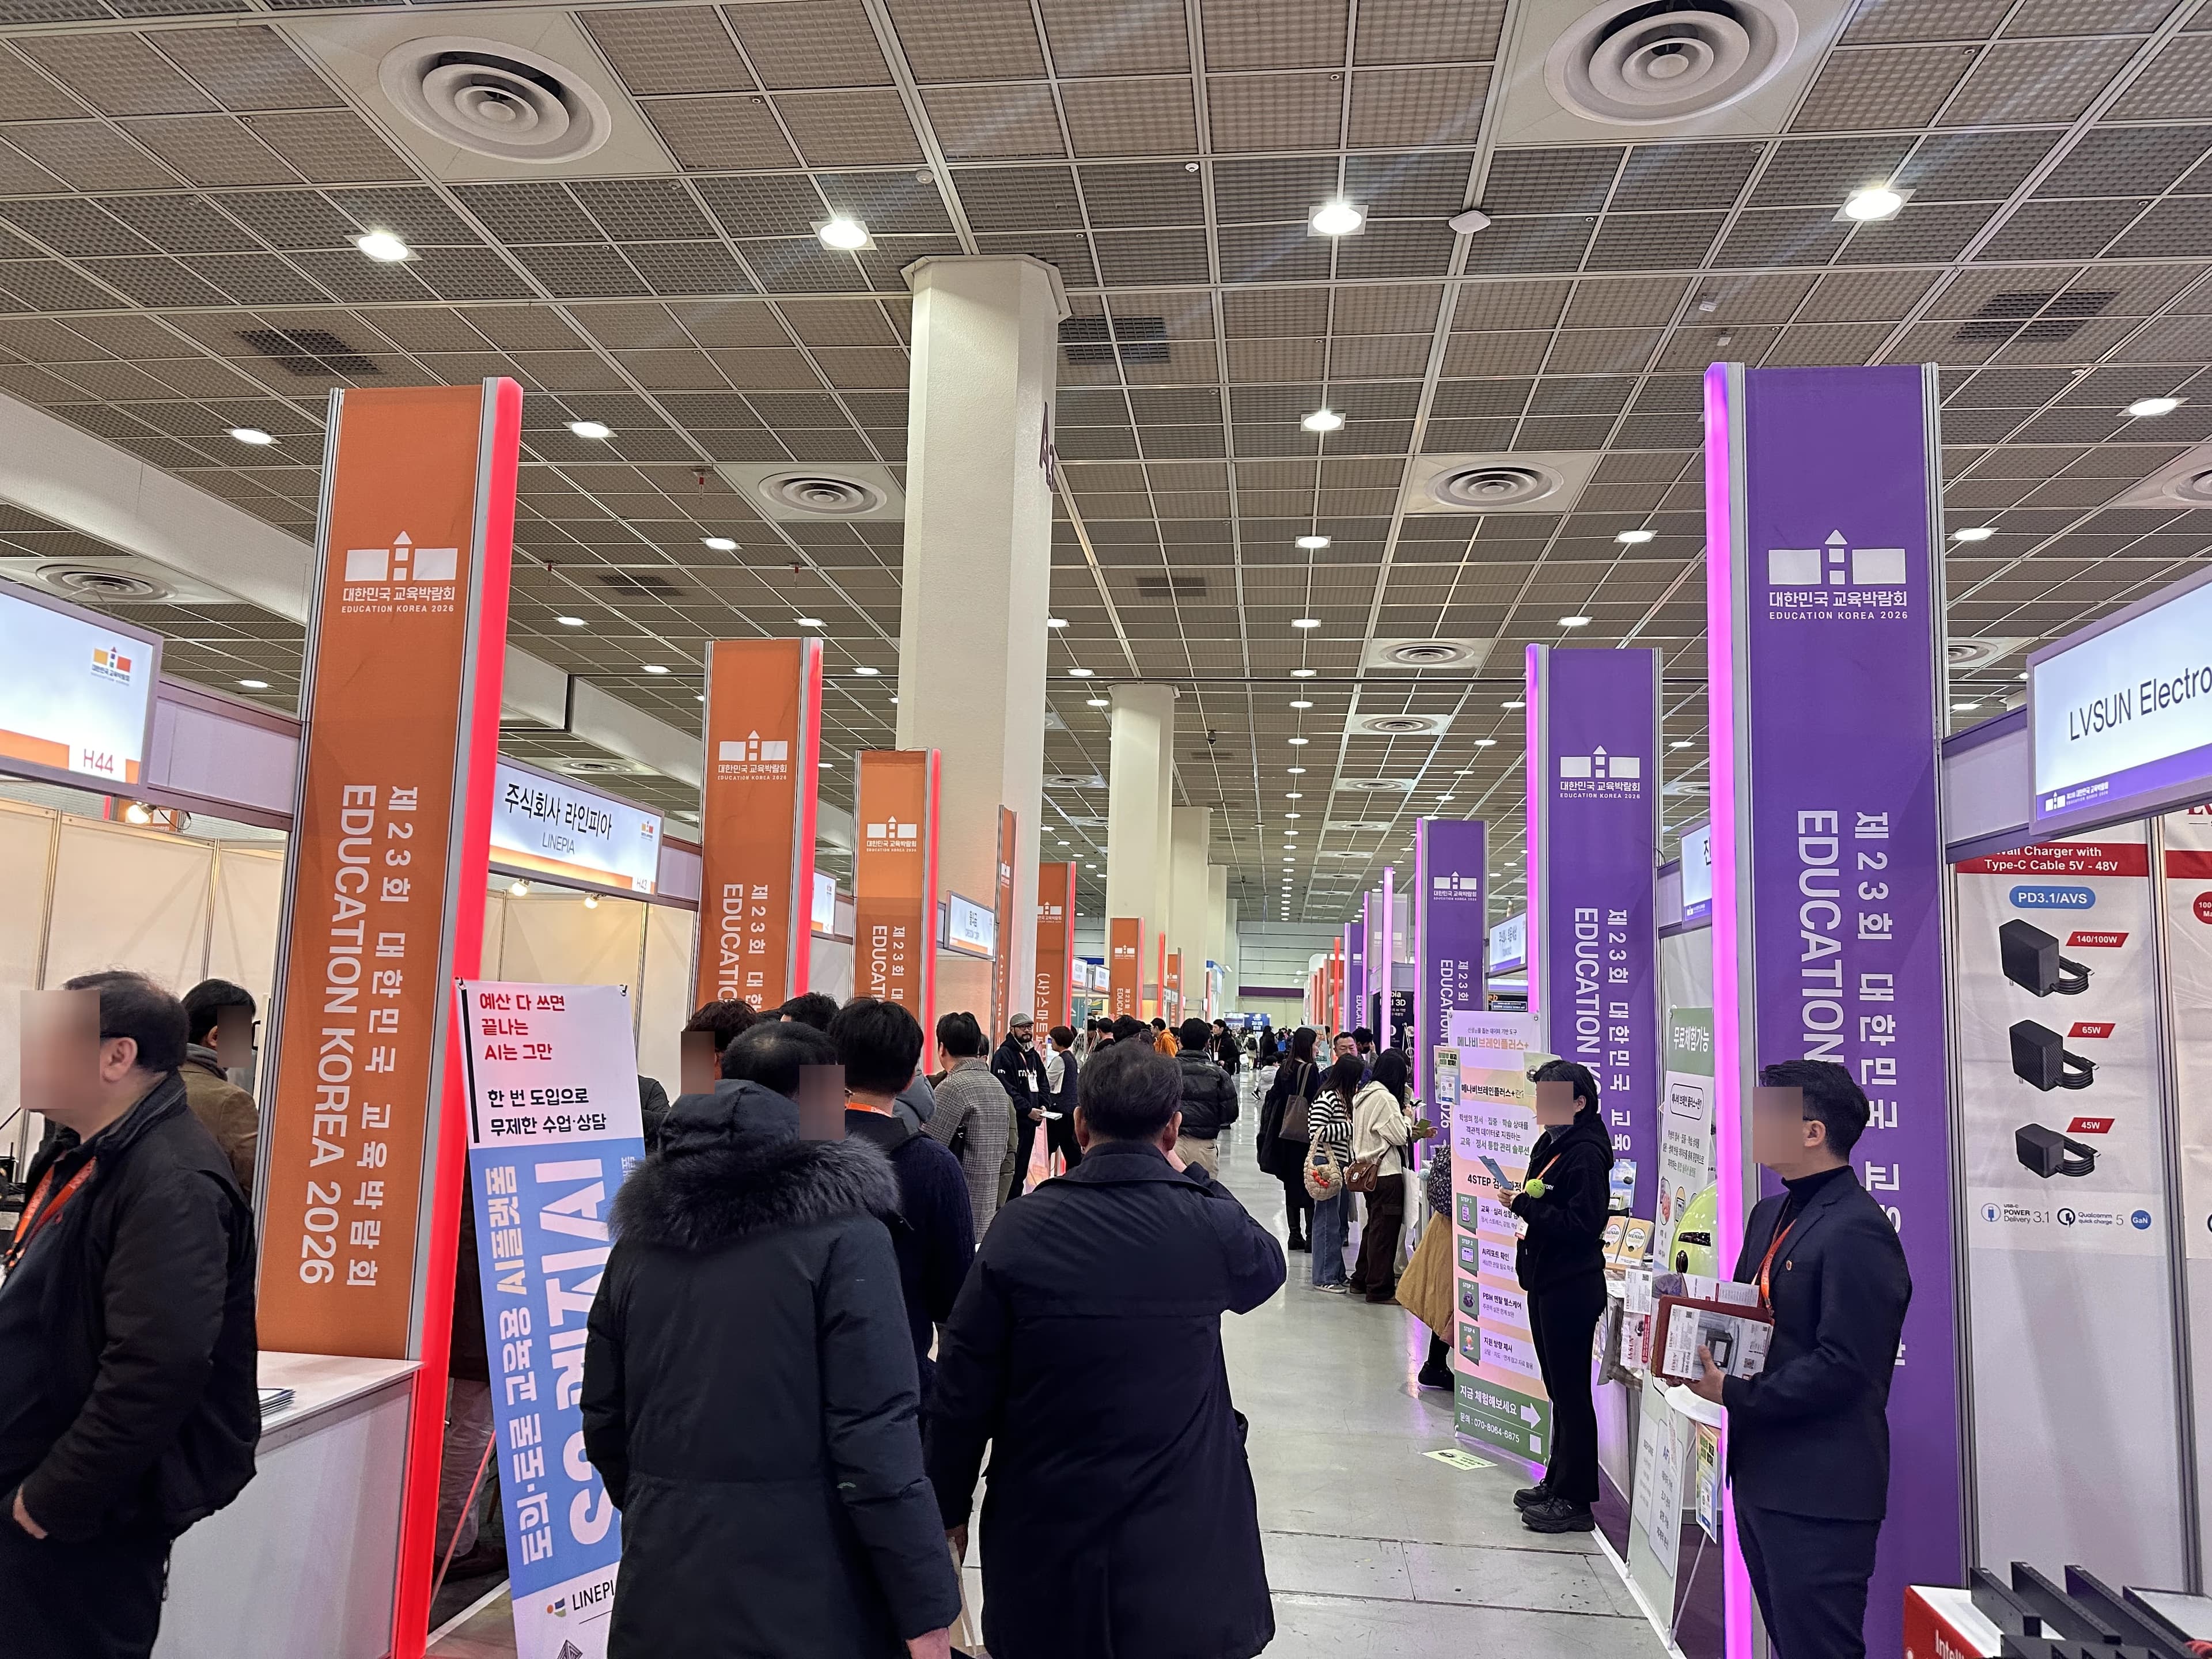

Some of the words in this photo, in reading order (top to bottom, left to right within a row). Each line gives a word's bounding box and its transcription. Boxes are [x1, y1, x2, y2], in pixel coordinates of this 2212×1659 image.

[343, 587, 391, 601] 대한민국
[393, 586, 455, 601] 교육박람회
[1769, 592, 1828, 608] 대한민국
[1833, 590, 1907, 607] 교육박람회
[1838, 612, 1874, 620] KOREA
[1880, 611, 1908, 619] 2026
[2070, 688, 2132, 741] LVSUN
[83, 749, 113, 774] H44
[718, 764, 748, 773] 대한민국
[749, 764, 787, 773] 교육박람회
[1560, 782, 1594, 791] 대한민국
[1597, 782, 1640, 791] 교육박람회
[505, 783, 560, 825] 주식회사
[565, 802, 612, 840] 라인피아
[380, 786, 418, 902] 제23회
[542, 832, 575, 855] LINEPIA
[2024, 846, 2073, 858] Charger
[2077, 847, 2101, 857] with
[1854, 811, 1893, 940] 제23회
[1984, 859, 2026, 871] Type-C
[2031, 860, 2065, 870] Cable
[2069, 861, 2084, 870] 5V
[2096, 862, 2118, 871] 48V
[324, 785, 377, 1013] EDUCATION
[2018, 893, 2088, 904] PD3.1/AVS
[748, 884, 769, 955] 제23회
[717, 884, 744, 1002] EDUCATIO
[891, 926, 905, 976] 제23회
[1607, 909, 1628, 983] 제23회
[1797, 810, 1844, 1063] EDUCATION
[870, 926, 887, 1001] EDUCATI
[745, 972, 764, 1012] 대한
[1458, 960, 1468, 1001] 제23회
[1574, 908, 1601, 1054] EDUCATION
[365, 933, 406, 1073] 대한민국
[480, 993, 510, 1010] 예산
[516, 995, 531, 1010] 다
[537, 995, 565, 1012] 쓰면
[1036, 972, 1050, 1034] (사)스마트
[482, 1018, 528, 1035] 끝나는
[1674, 1026, 1709, 1052] 무료체험가능
[485, 1044, 517, 1060] AI는
[523, 1044, 552, 1060] 그만
[1457, 1036, 1529, 1050] 메나비브레인플러스+
[1608, 1002, 1631, 1092] 대한민국
[1859, 974, 1898, 1130] 대한민국
[309, 1028, 355, 1167] KOREA
[488, 1089, 504, 1108] 한
[510, 1089, 525, 1107] 번
[530, 1088, 589, 1105] 도입으로
[491, 1116, 537, 1136] 무제한
[543, 1113, 607, 1134] 수업·상담
[1459, 1113, 1472, 1123] 학생의
[1474, 1115, 1483, 1124] 정서
[1488, 1117, 1498, 1126] 집중
[1502, 1119, 1512, 1127] 학습
[1513, 1120, 1528, 1130] 상태를
[1481, 1128, 1500, 1137] 데이터로
[1501, 1131, 1521, 1141] 지원하는
[1460, 1137, 1470, 1146] 교육
[1476, 1139, 1486, 1149] 정서
[1488, 1141, 1498, 1151] 통합
[1499, 1143, 1510, 1153] 관리
[1512, 1145, 1529, 1156] 솔루션
[346, 1102, 391, 1286] 교육박람회
[1468, 1174, 1491, 1186] 4STEP
[1481, 1205, 1490, 1213] 교육
[2004, 1216, 2031, 1224] Delivery
[2033, 1211, 2049, 1223] 3.1
[2116, 1215, 2124, 1226] 5
[299, 1181, 342, 1285] 2026
[485, 1165, 527, 1296] AI플랫폼
[1482, 1248, 1499, 1258] AI리포트
[1500, 1252, 1509, 1262] 확인
[499, 1306, 537, 1406] 교육용
[1484, 1337, 1493, 1346] 지원
[1494, 1340, 1502, 1349] 방향
[1503, 1343, 1513, 1353] 제시
[1460, 1385, 1474, 1399] 지금
[1475, 1390, 1517, 1415] 체험해보세요
[1460, 1412, 1470, 1424] 문의
[1474, 1418, 1520, 1443] 070-8064-6875
[509, 1413, 553, 1565] 토의·토론
[573, 1580, 614, 1611] LINEPI
